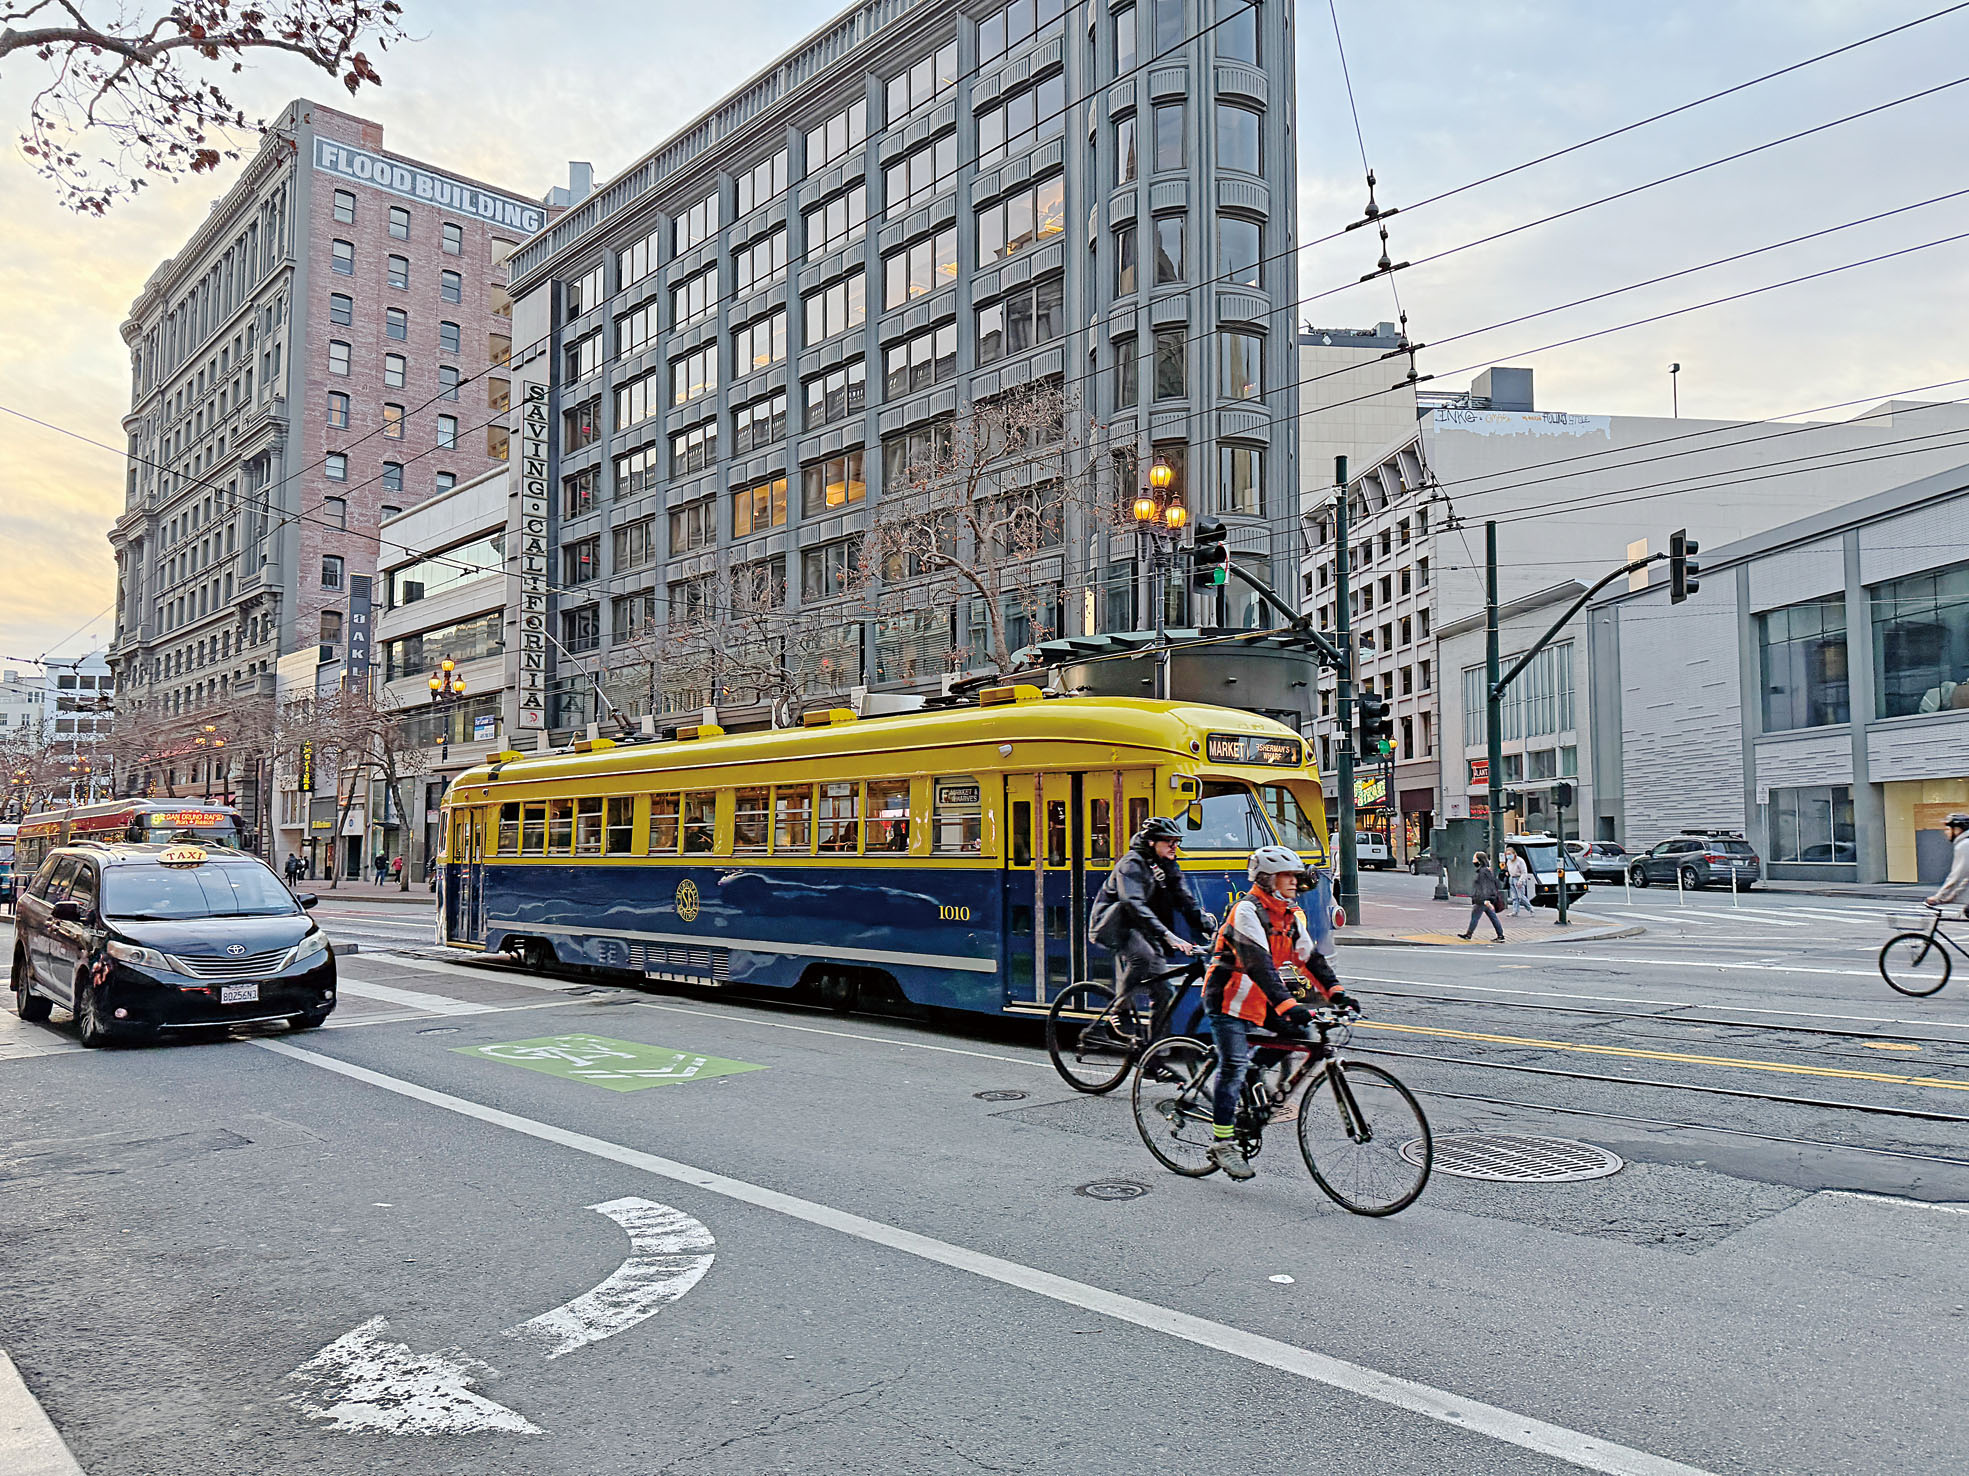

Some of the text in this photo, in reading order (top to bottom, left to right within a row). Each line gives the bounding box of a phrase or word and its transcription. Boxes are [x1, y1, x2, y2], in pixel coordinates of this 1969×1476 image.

[322, 143, 539, 231] FLOOD BUILDING
[523, 385, 546, 708] SAVING CALIFORNIA
[351, 613, 366, 694] OAKL
[1209, 740, 1244, 758] MARKET
[166, 851, 203, 861] TAXI
[938, 905, 970, 921] 1010
